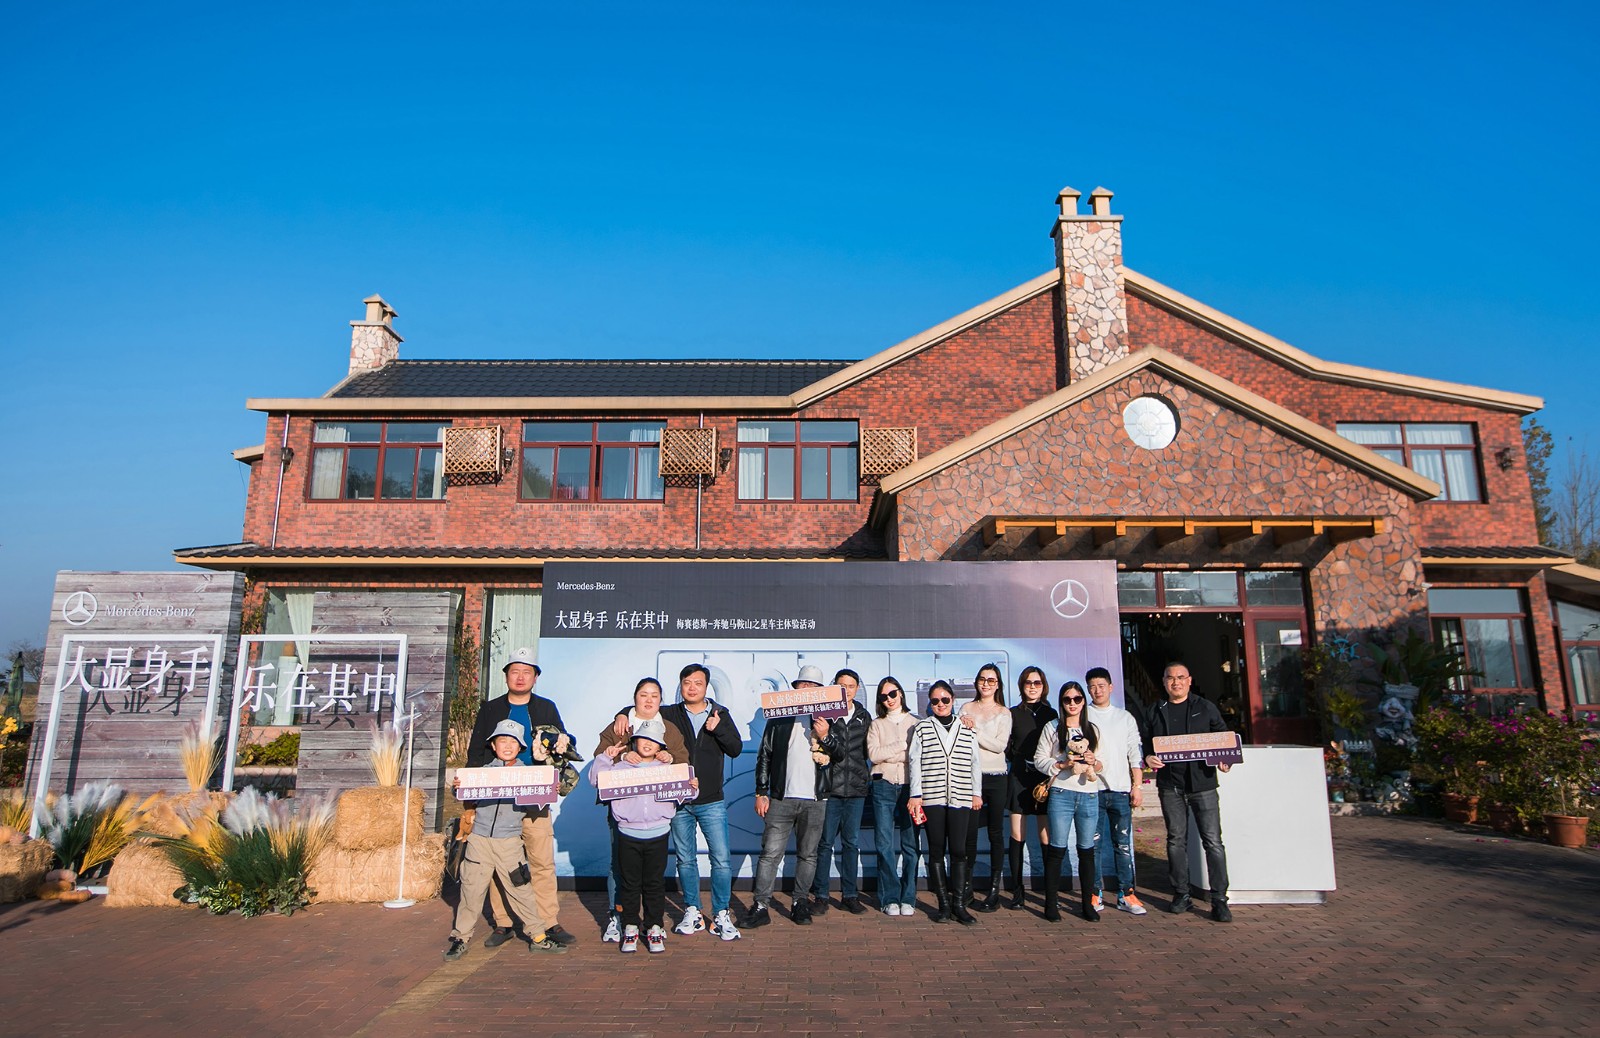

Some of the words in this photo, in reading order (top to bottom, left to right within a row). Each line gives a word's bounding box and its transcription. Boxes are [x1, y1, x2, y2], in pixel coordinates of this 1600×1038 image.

[556, 581, 616, 591] Mercedes-Benz
[104, 604, 196, 617] Mercedes-Benz
[554, 610, 609, 630] 大显身手
[615, 610, 669, 630] 乐在其中
[59, 644, 211, 694] 大显身手
[238, 662, 397, 713] 乐在其中
